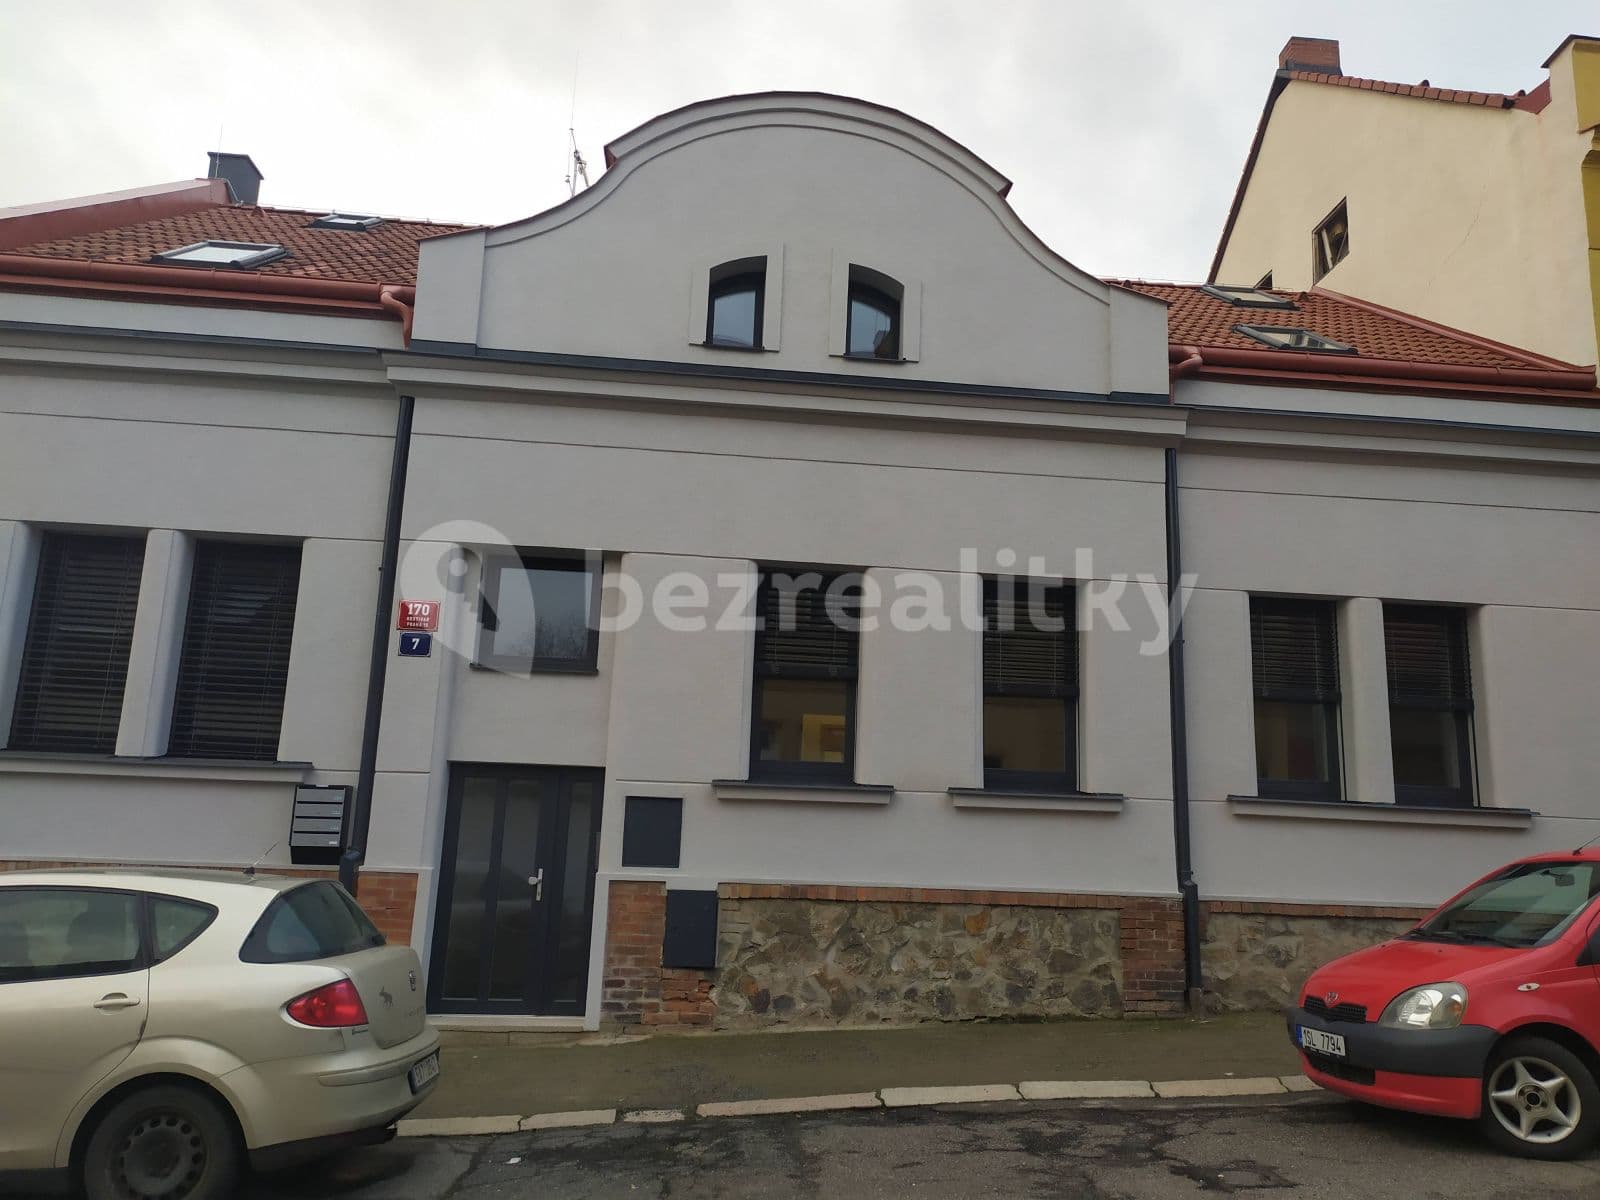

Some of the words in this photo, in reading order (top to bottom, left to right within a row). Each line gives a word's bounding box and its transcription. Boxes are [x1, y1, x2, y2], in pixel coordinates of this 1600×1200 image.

[407, 603, 430, 615] 170
[411, 638, 420, 650] 7
[1303, 1029, 1317, 1047] 1SL
[1320, 1033, 1342, 1053] 7794
